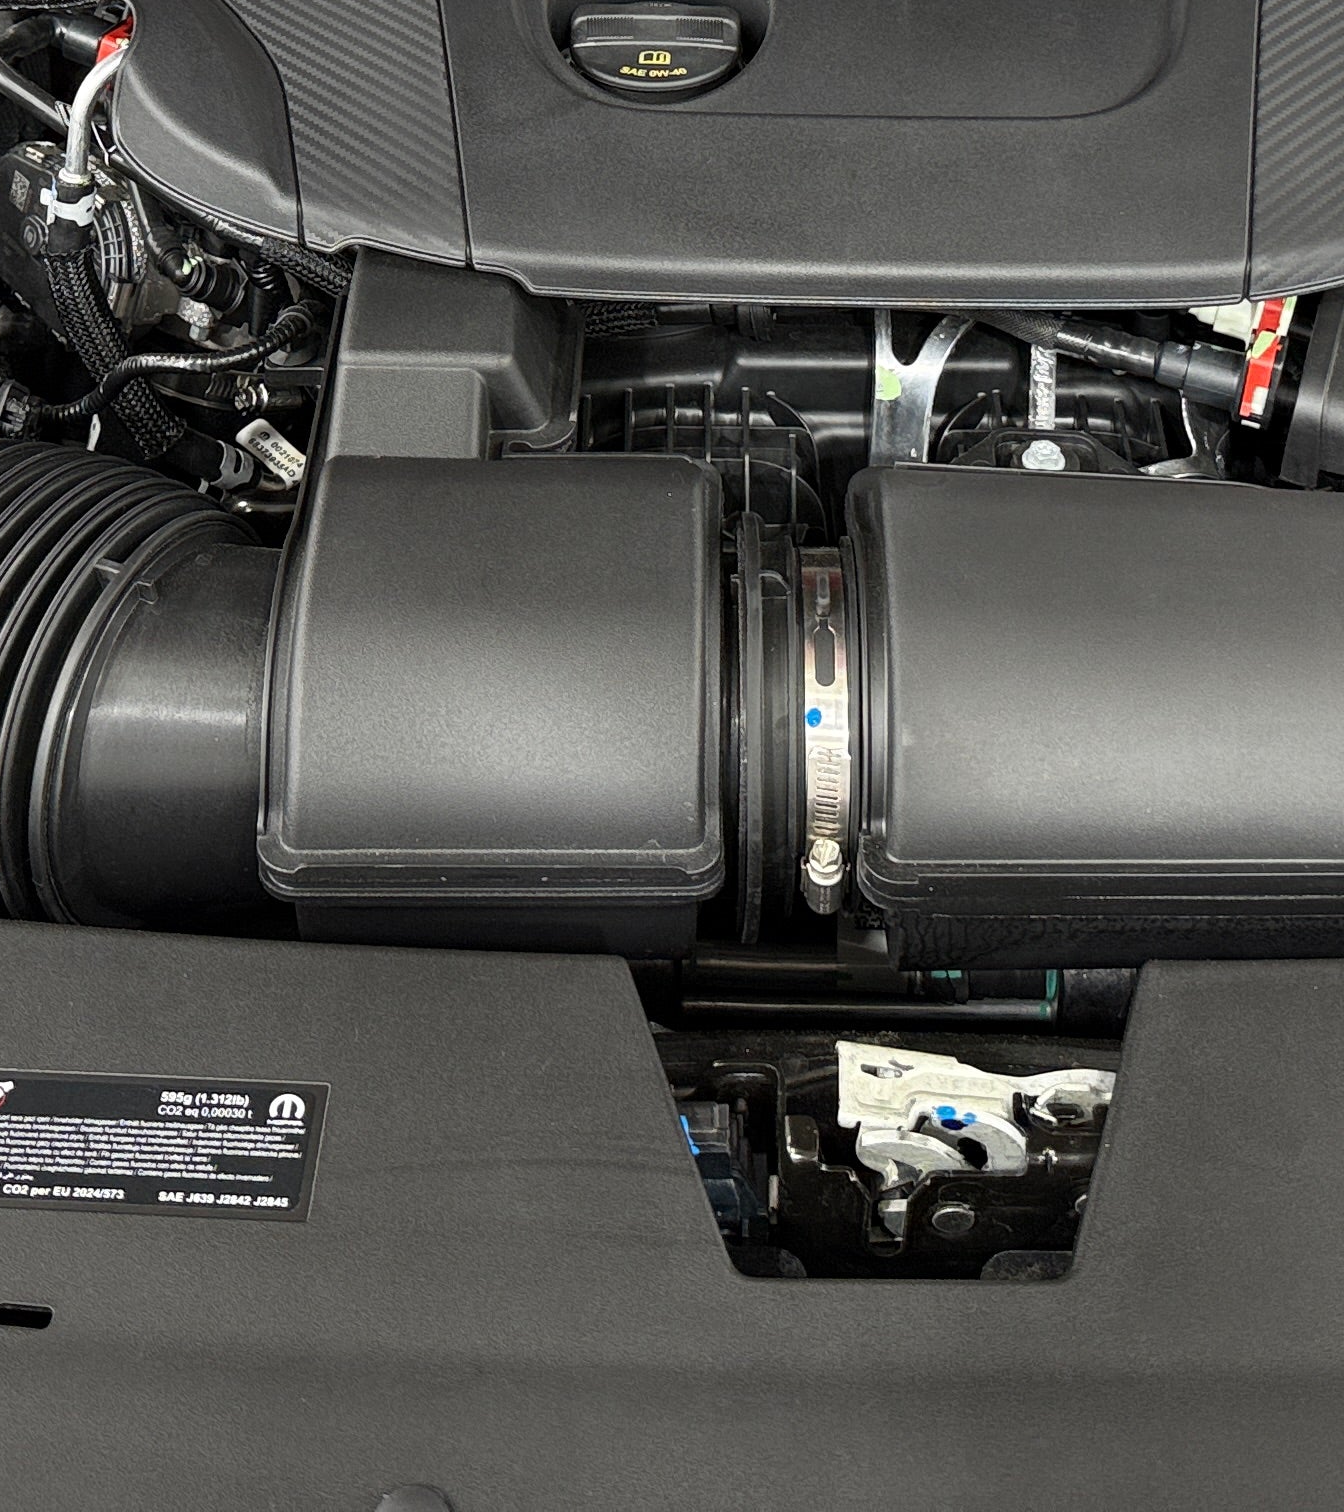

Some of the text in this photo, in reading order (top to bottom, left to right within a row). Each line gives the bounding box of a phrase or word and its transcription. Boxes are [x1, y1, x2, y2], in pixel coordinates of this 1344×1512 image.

[620, 66, 688, 78] SAE 0W-40
[160, 1091, 193, 1106] 595g
[158, 1105, 183, 1117] CO2
[3, 1183, 29, 1195] CO2
[30, 1187, 51, 1198] per
[53, 1186, 71, 1196] EU
[158, 1190, 185, 1203] SAE
